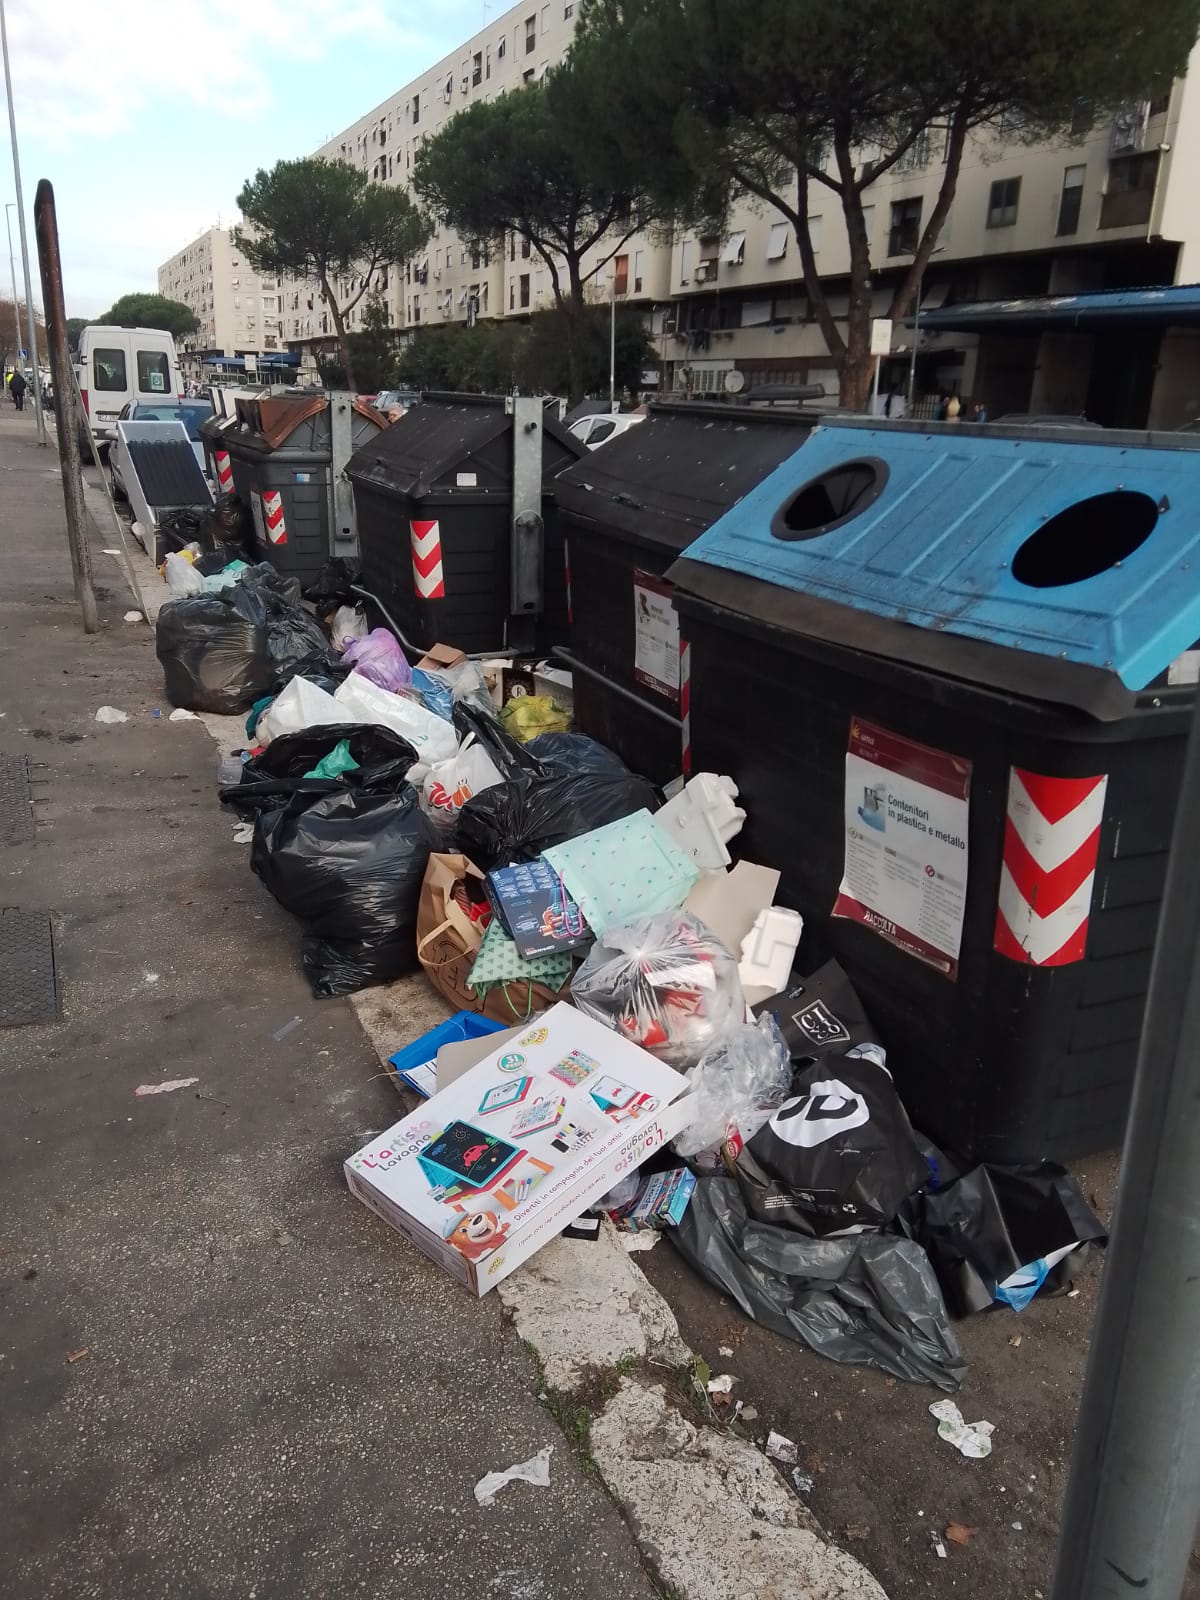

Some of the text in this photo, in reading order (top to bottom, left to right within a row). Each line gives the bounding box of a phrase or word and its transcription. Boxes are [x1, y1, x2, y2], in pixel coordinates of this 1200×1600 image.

[888, 794, 929, 820] Contenitori
[888, 807, 965, 850] in plastica e metallo
[863, 910, 896, 936] RACCOLTA
[507, 1054, 520, 1064] 31
[362, 1120, 431, 1168] L'artista
[379, 1134, 431, 1171] Lavagna
[614, 1128, 664, 1174] L'artista
[620, 1121, 658, 1155] Lavagna
[514, 1132, 624, 1221] Divertiti in compagnia dei tuoi amici
